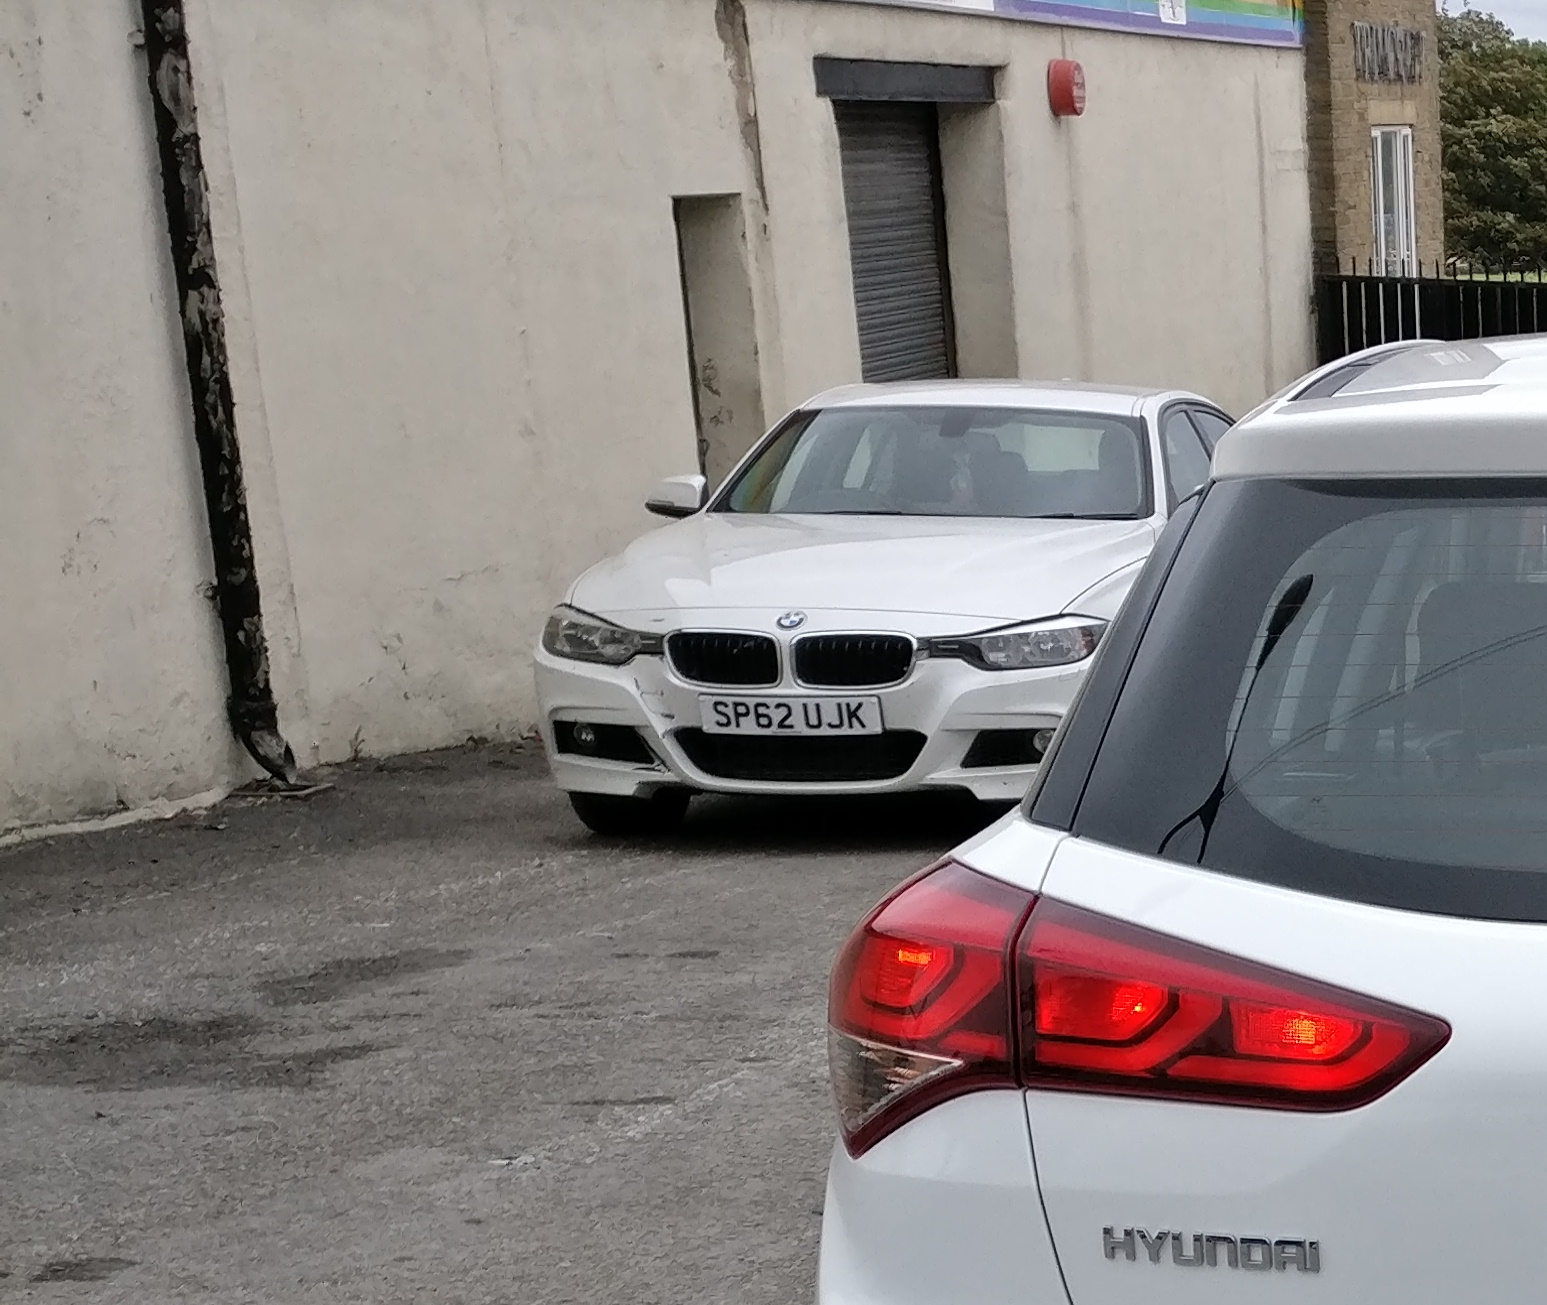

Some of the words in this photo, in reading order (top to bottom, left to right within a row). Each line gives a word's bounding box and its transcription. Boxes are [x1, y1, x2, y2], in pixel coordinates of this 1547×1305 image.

[712, 701, 795, 730] SP62
[802, 702, 866, 730] UJK
[1103, 1225, 1321, 1274] HYUNDAI
